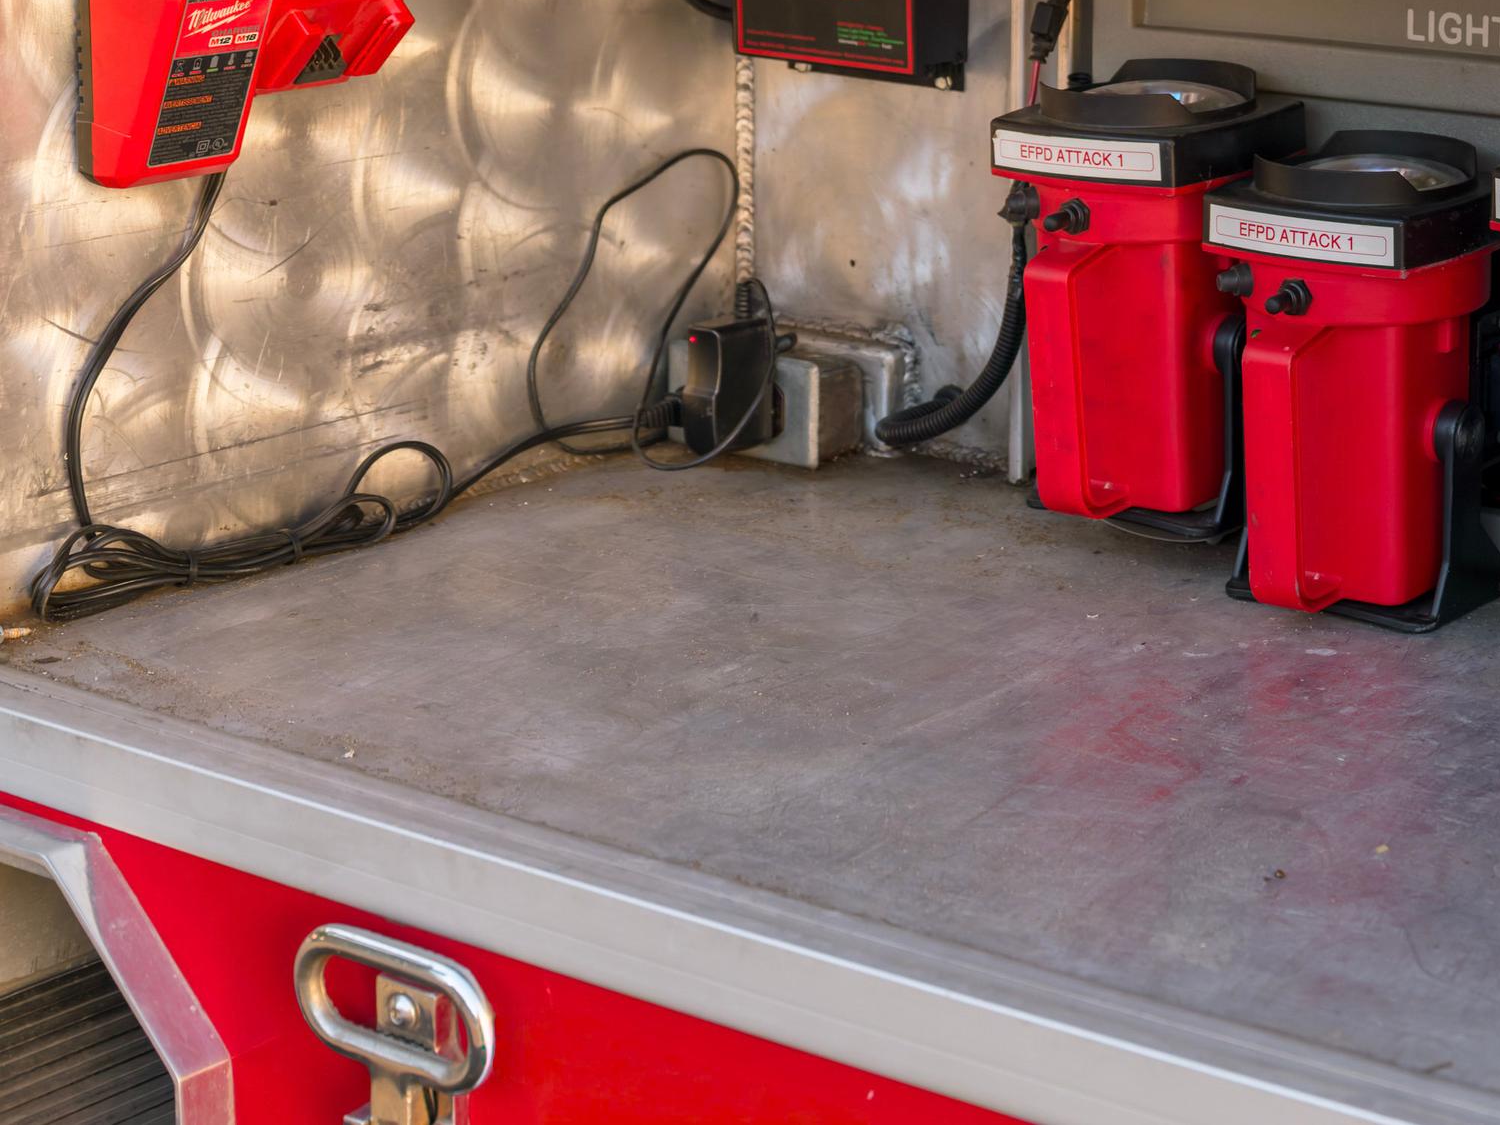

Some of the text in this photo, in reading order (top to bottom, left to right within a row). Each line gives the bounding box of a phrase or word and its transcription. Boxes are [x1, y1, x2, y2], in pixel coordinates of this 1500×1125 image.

[210, 34, 257, 45] M12 M18
[1020, 144, 1124, 167] EFPD ATTACK 1
[1239, 222, 1353, 251] EFPD ATTACK 1
